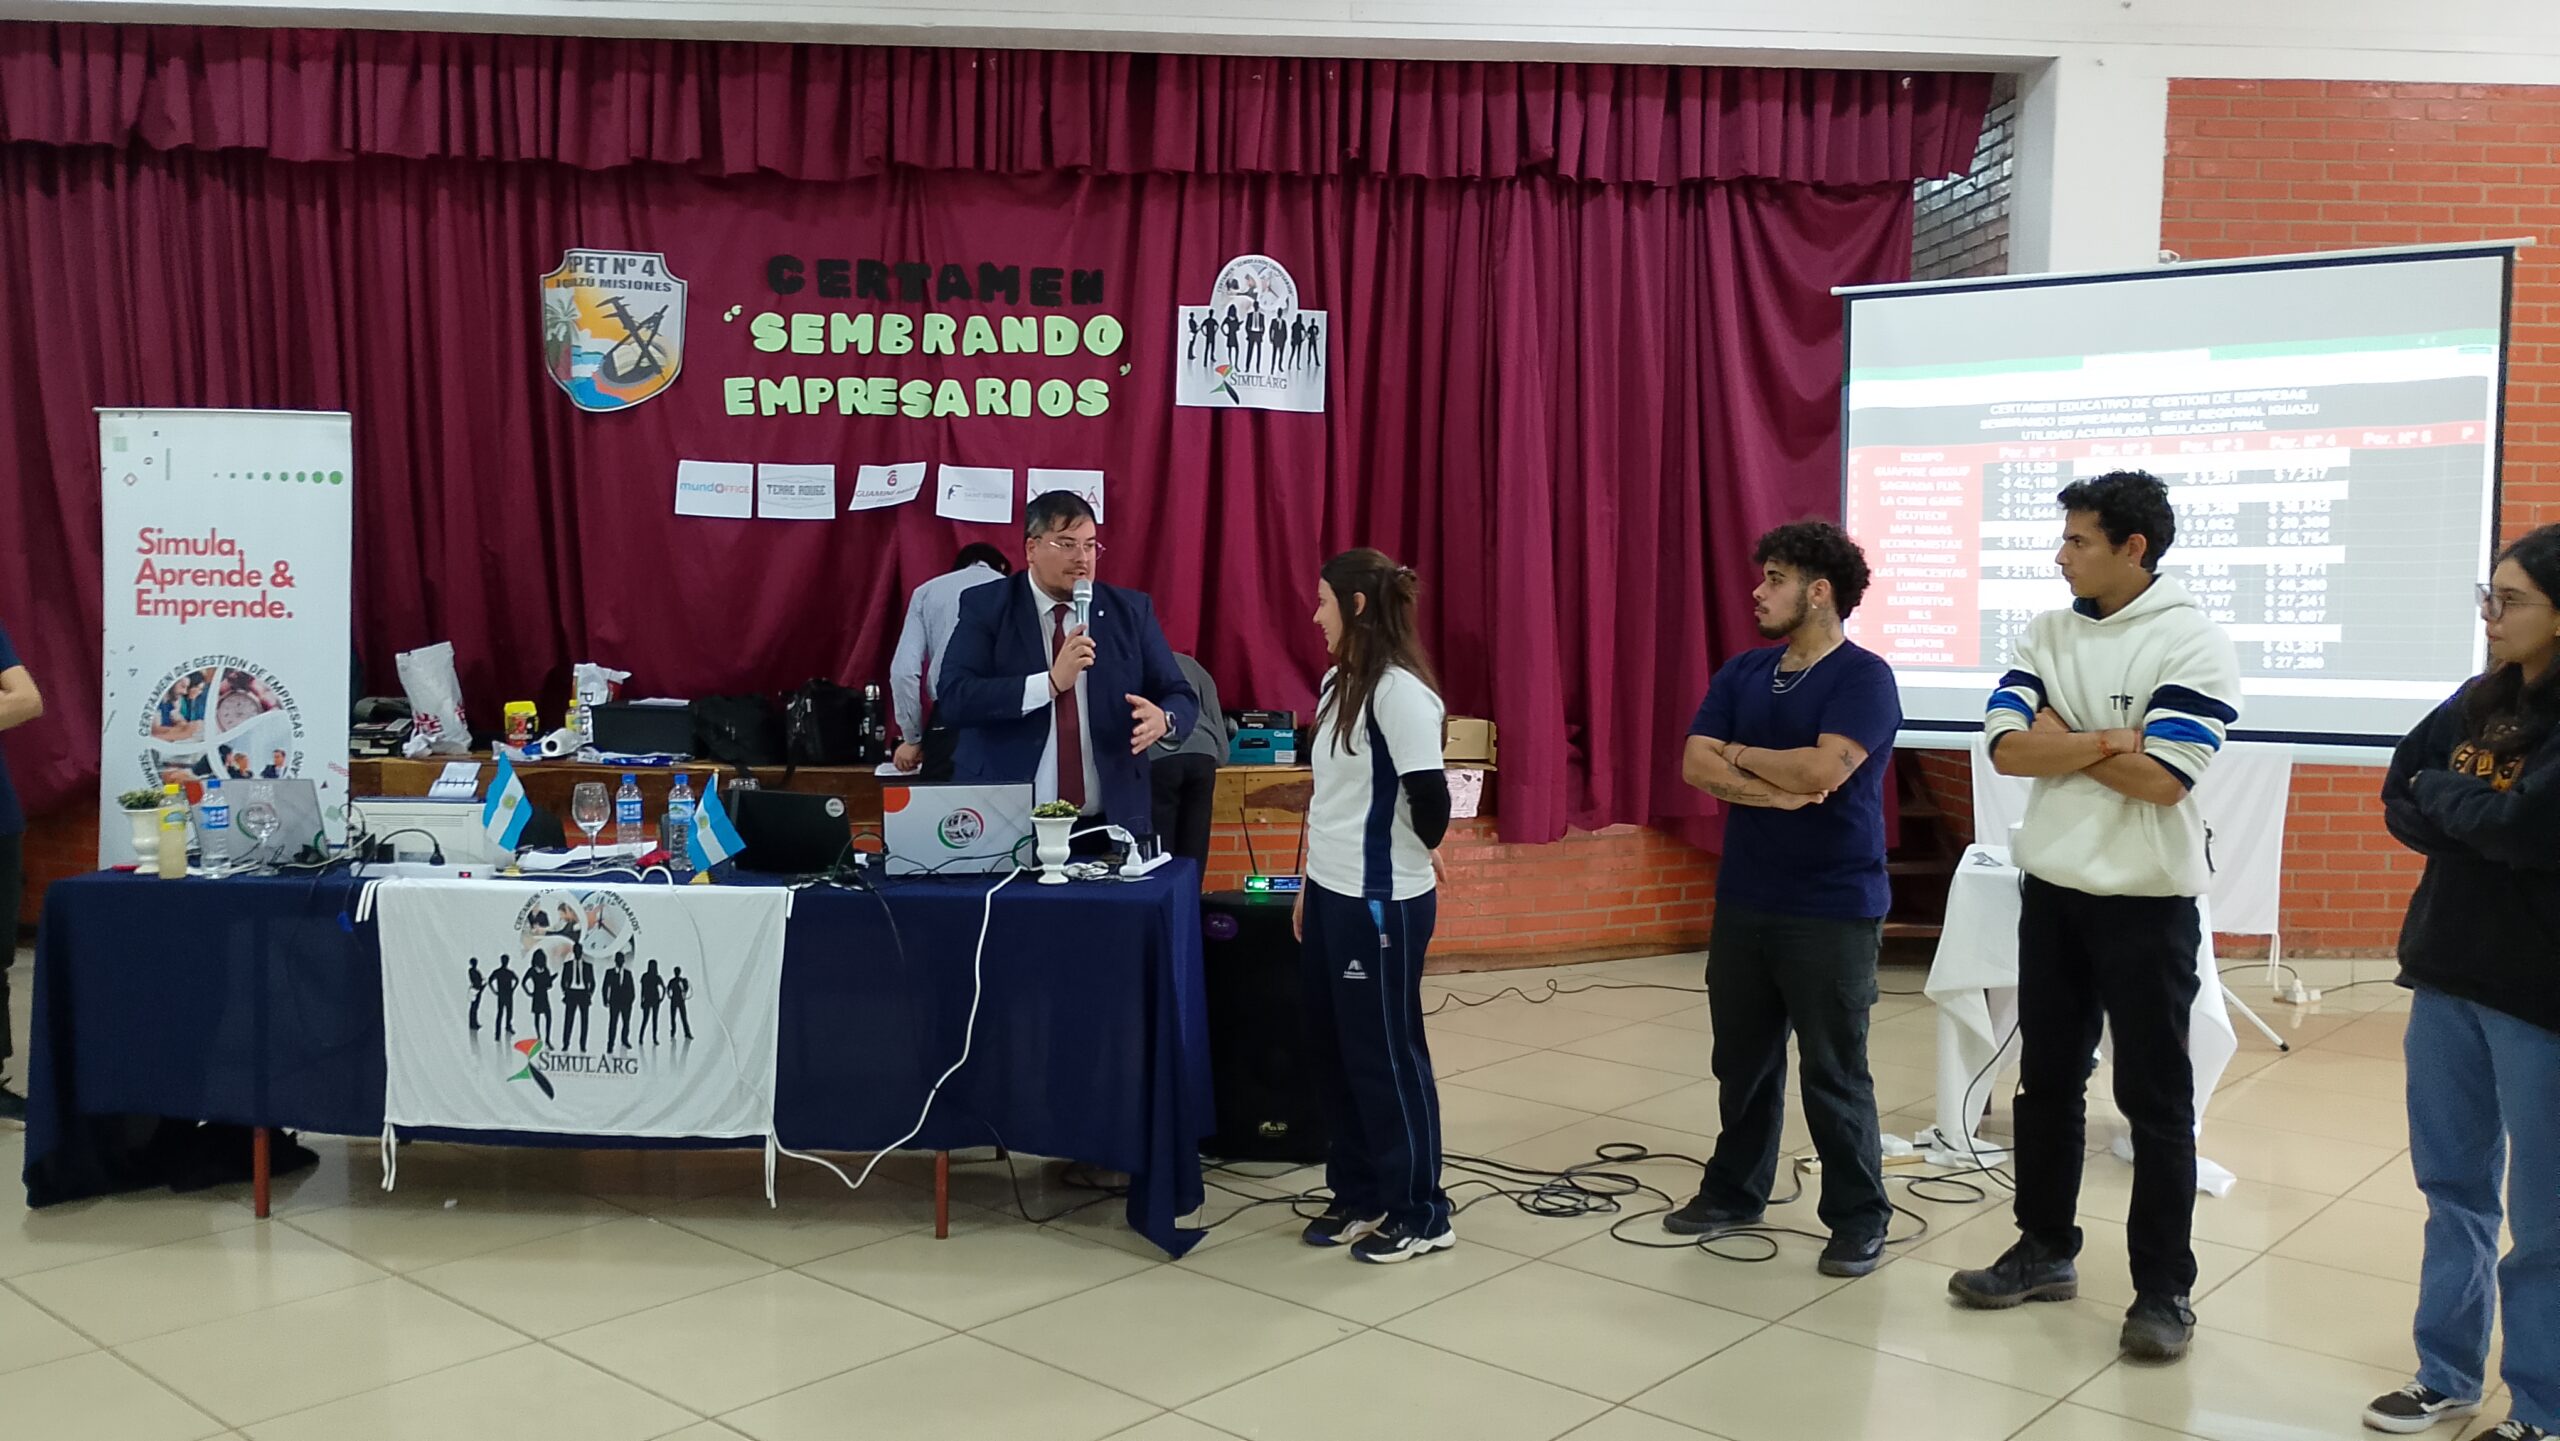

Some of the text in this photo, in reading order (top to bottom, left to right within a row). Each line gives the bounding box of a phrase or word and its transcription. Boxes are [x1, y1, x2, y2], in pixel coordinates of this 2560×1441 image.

[599, 278, 672, 292] MISIONES
[641, 259, 656, 277] 4
[767, 254, 1104, 306] CERTAMEN
[2058, 398, 2131, 412] EDUCATIVO
[2132, 396, 2151, 409] DE
[2212, 392, 2231, 405] DE
[136, 527, 244, 562] Simula,
[134, 558, 297, 593] Aprende &
[135, 588, 293, 625] Emprende.
[138, 654, 305, 739] CERTAMEN DE GESTION DE EMPRESAS
